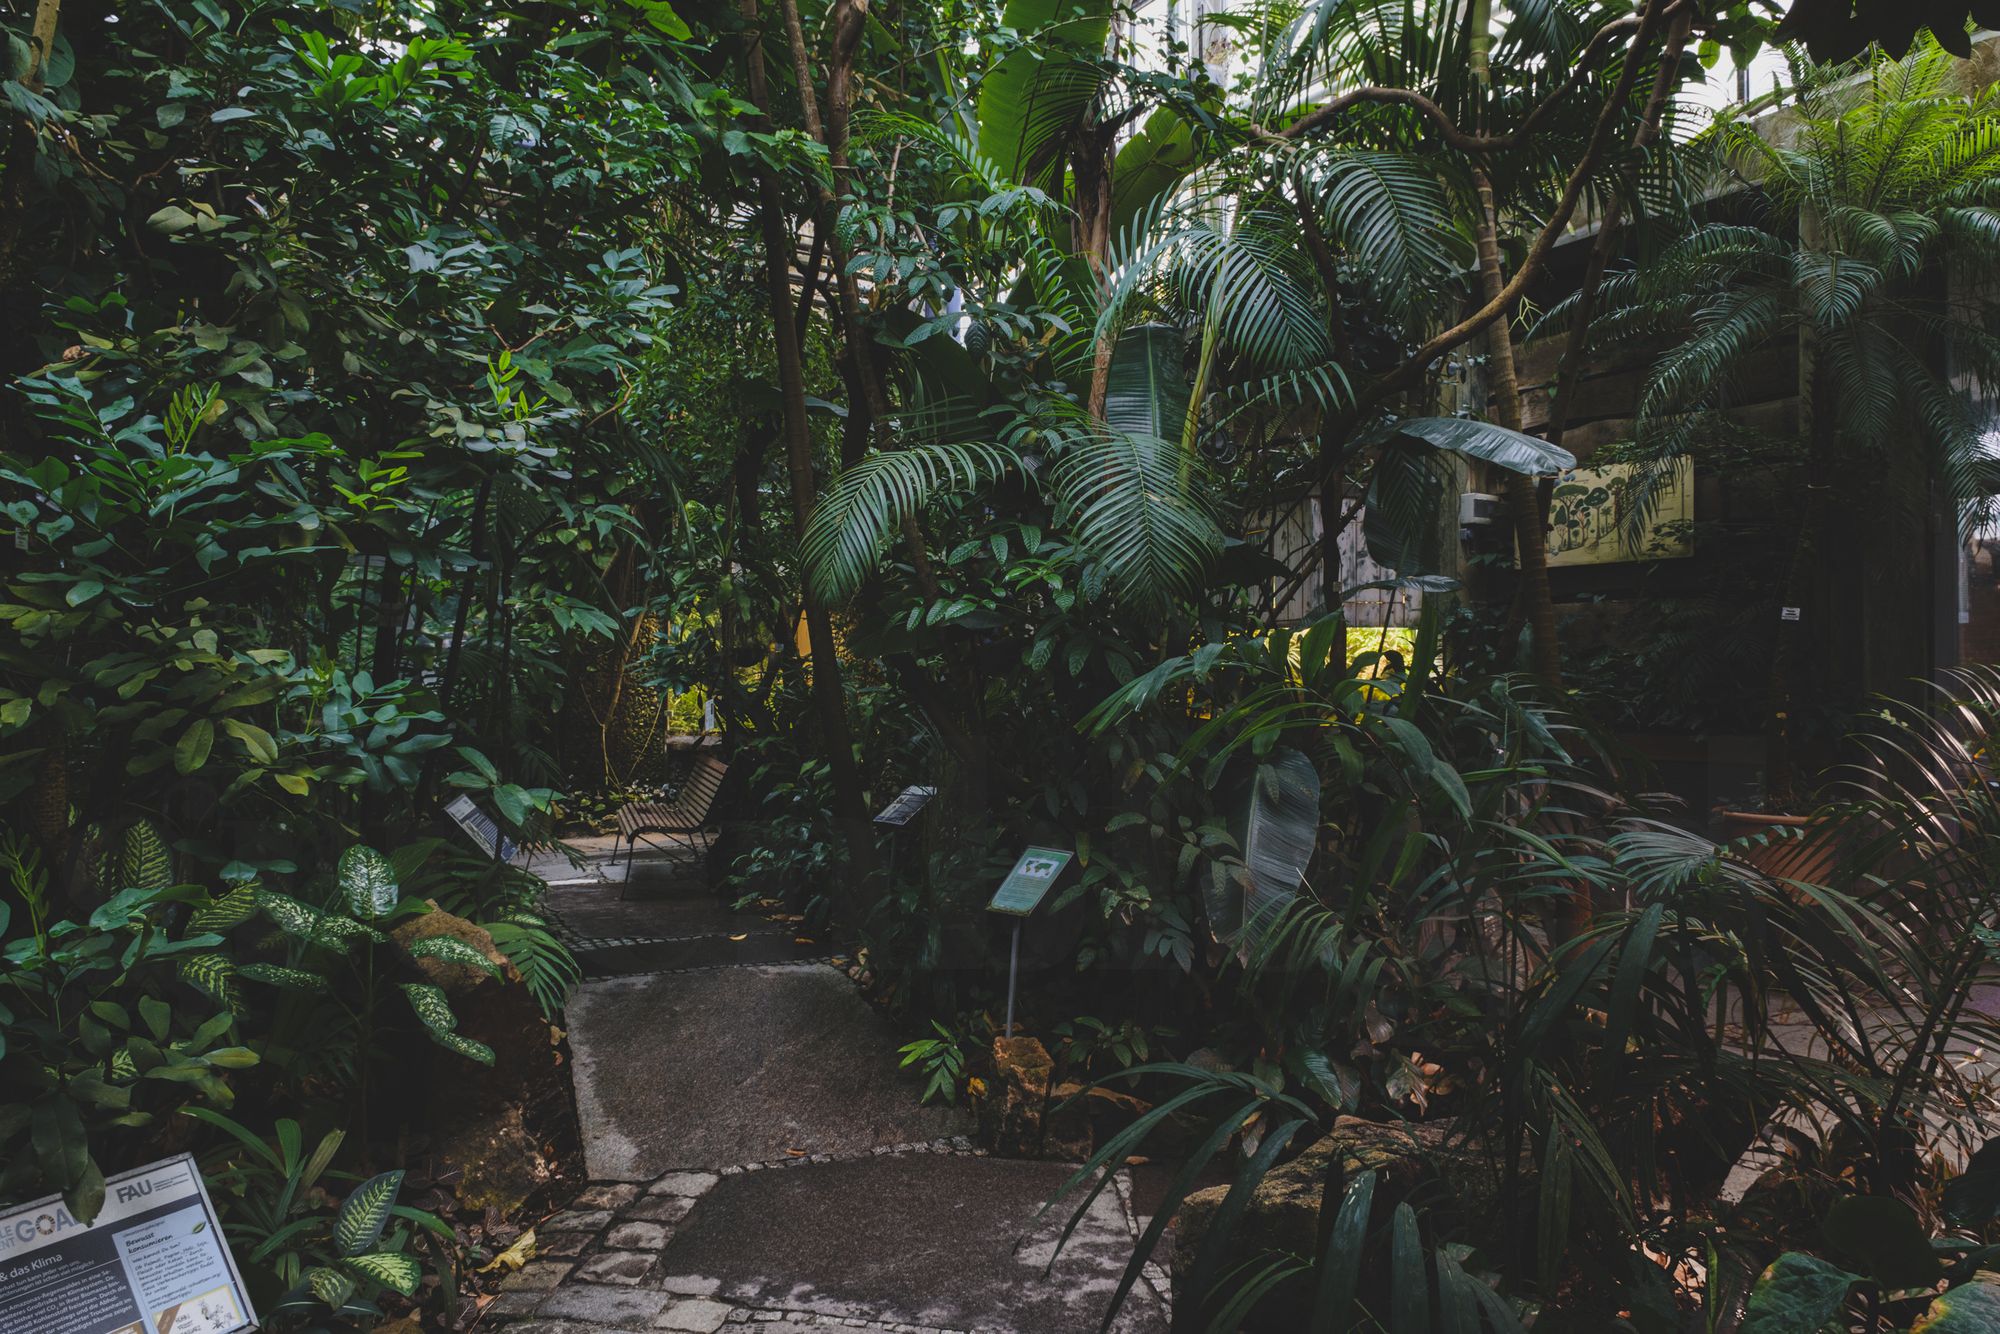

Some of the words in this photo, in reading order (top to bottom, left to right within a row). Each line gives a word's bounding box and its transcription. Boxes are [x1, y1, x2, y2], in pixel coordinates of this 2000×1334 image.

[116, 1179, 152, 1204] FAU
[125, 1232, 154, 1247] Bewusst
[127, 1235, 173, 1254] konsumieren
[10, 1265, 30, 1278] das
[31, 1254, 63, 1270] Klima
[27, 1274, 42, 1282] kann
[9, 1280, 81, 1311] Amazonas-Regenwaldes
[13, 1314, 33, 1324] bisher
[34, 1308, 46, 1316] viel
[80, 1285, 108, 1299] Biomasse
[26, 1297, 58, 1312] Großrisiko
[33, 1306, 68, 1324] Kohlenstoff
[98, 1289, 117, 1299] Durch
[76, 1306, 89, 1315] und
[89, 1300, 123, 1317] Trockenheit
[92, 1312, 113, 1324] Bäume
